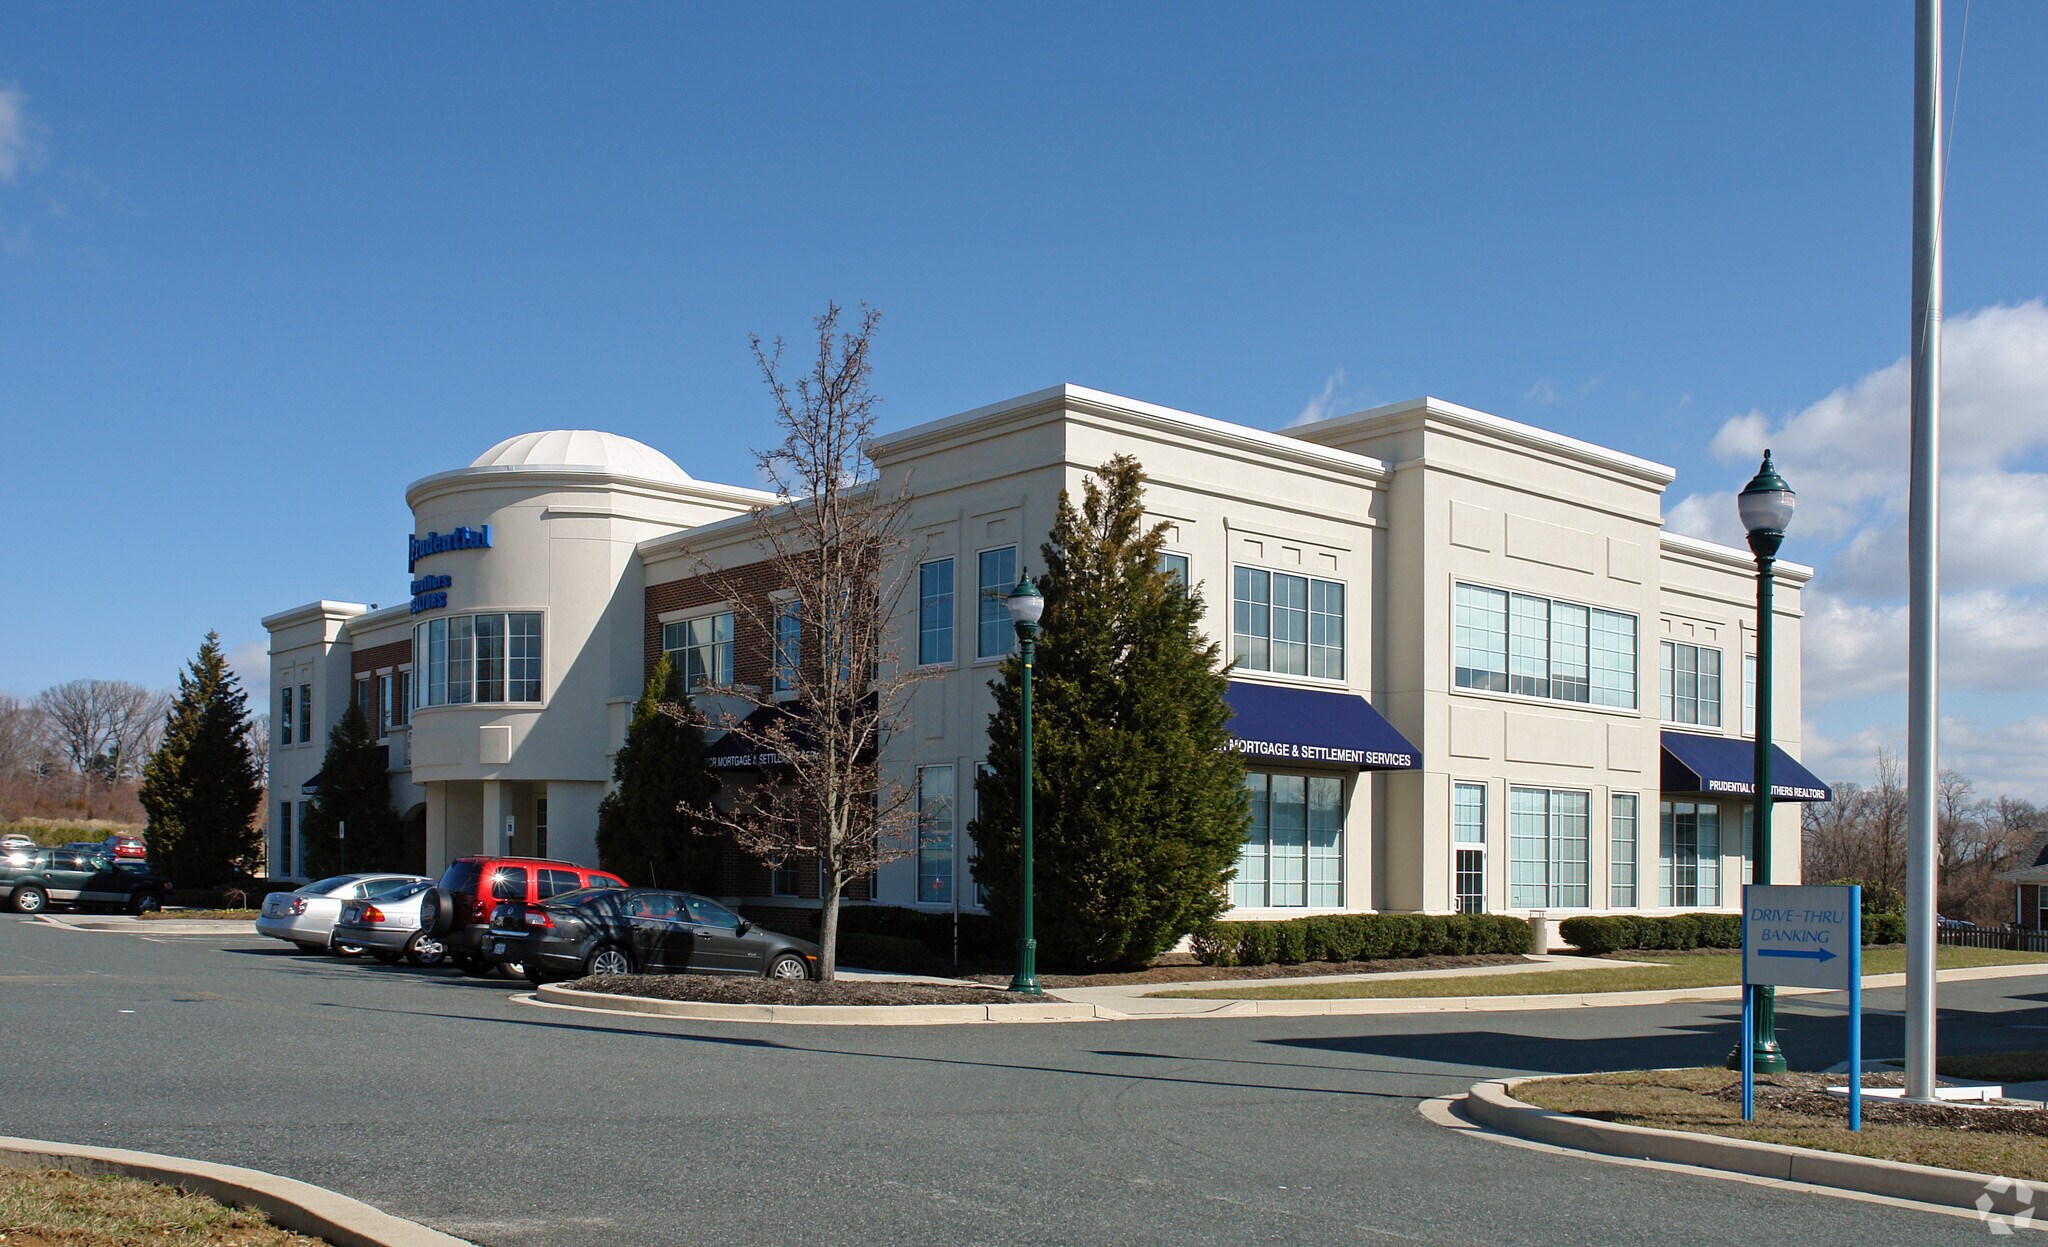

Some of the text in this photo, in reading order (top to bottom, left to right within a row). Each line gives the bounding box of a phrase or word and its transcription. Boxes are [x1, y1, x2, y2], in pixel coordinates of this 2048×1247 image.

[410, 524, 492, 562] Prudential
[717, 754, 752, 768] MORTGAGE
[1229, 738, 1290, 757] MORTGAGE
[1292, 744, 1299, 758] &
[1301, 745, 1364, 763] SETTLEMENT
[1366, 751, 1411, 767] SERVICES
[1709, 780, 1750, 793] PRUDENTIAL
[1794, 786, 1825, 799] REALTORS
[1751, 908, 1845, 944] DRIVE-THRU BANKING
